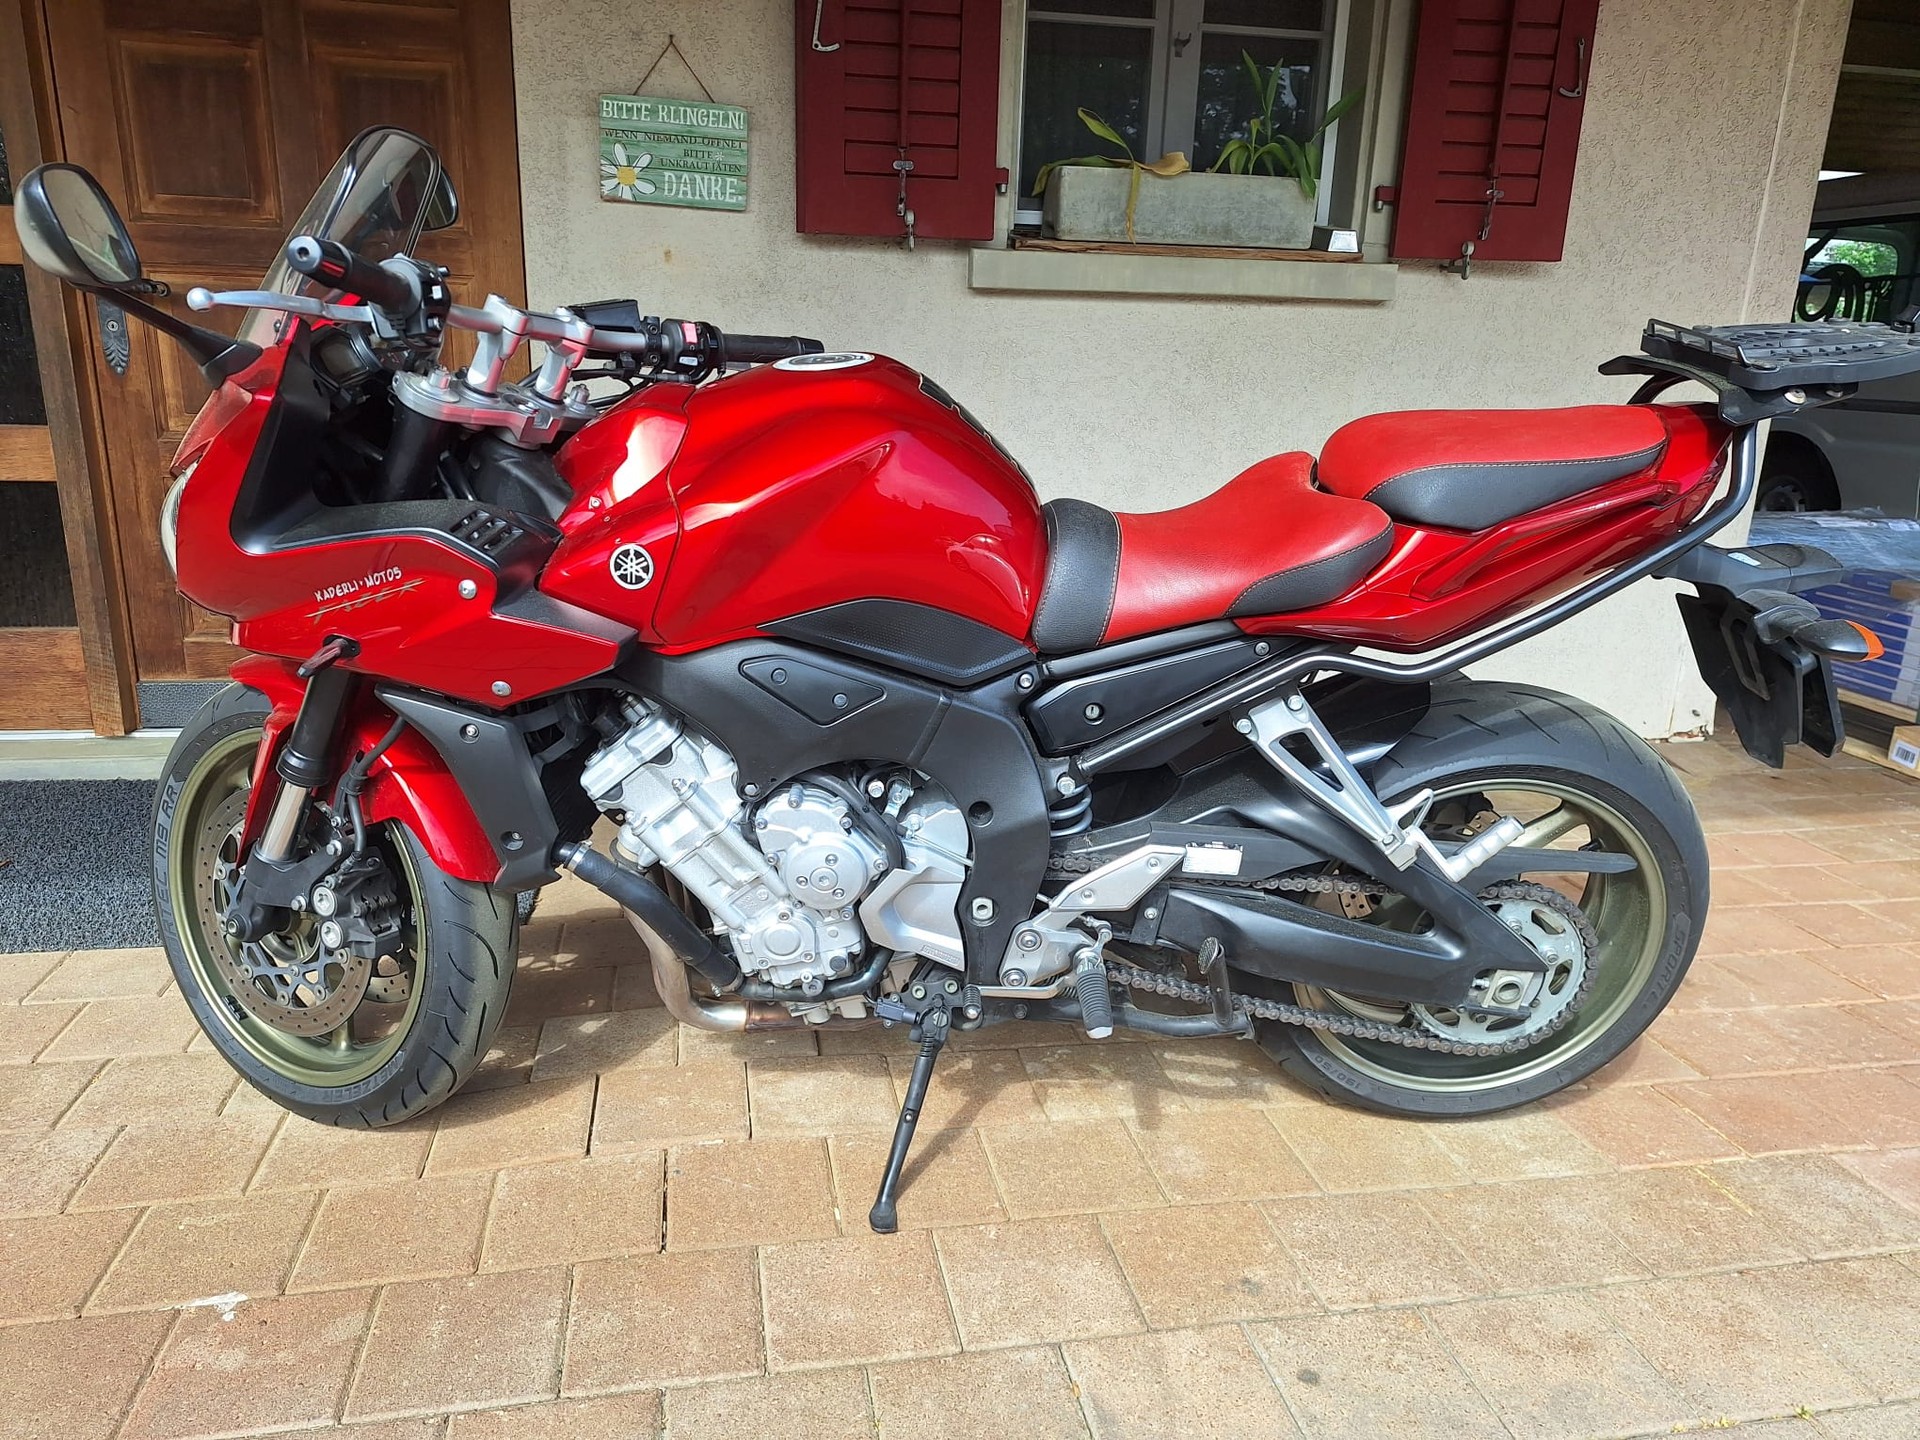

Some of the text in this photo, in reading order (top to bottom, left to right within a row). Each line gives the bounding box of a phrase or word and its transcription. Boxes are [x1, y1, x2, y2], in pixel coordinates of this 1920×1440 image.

[602, 99, 744, 130] BITTE KLINGELN!
[605, 130, 638, 140] WENN
[645, 132, 697, 145] NIEMAND
[683, 149, 713, 159] BITTE
[660, 158, 709, 170] UNKRAUT
[161, 785, 178, 819] RR
